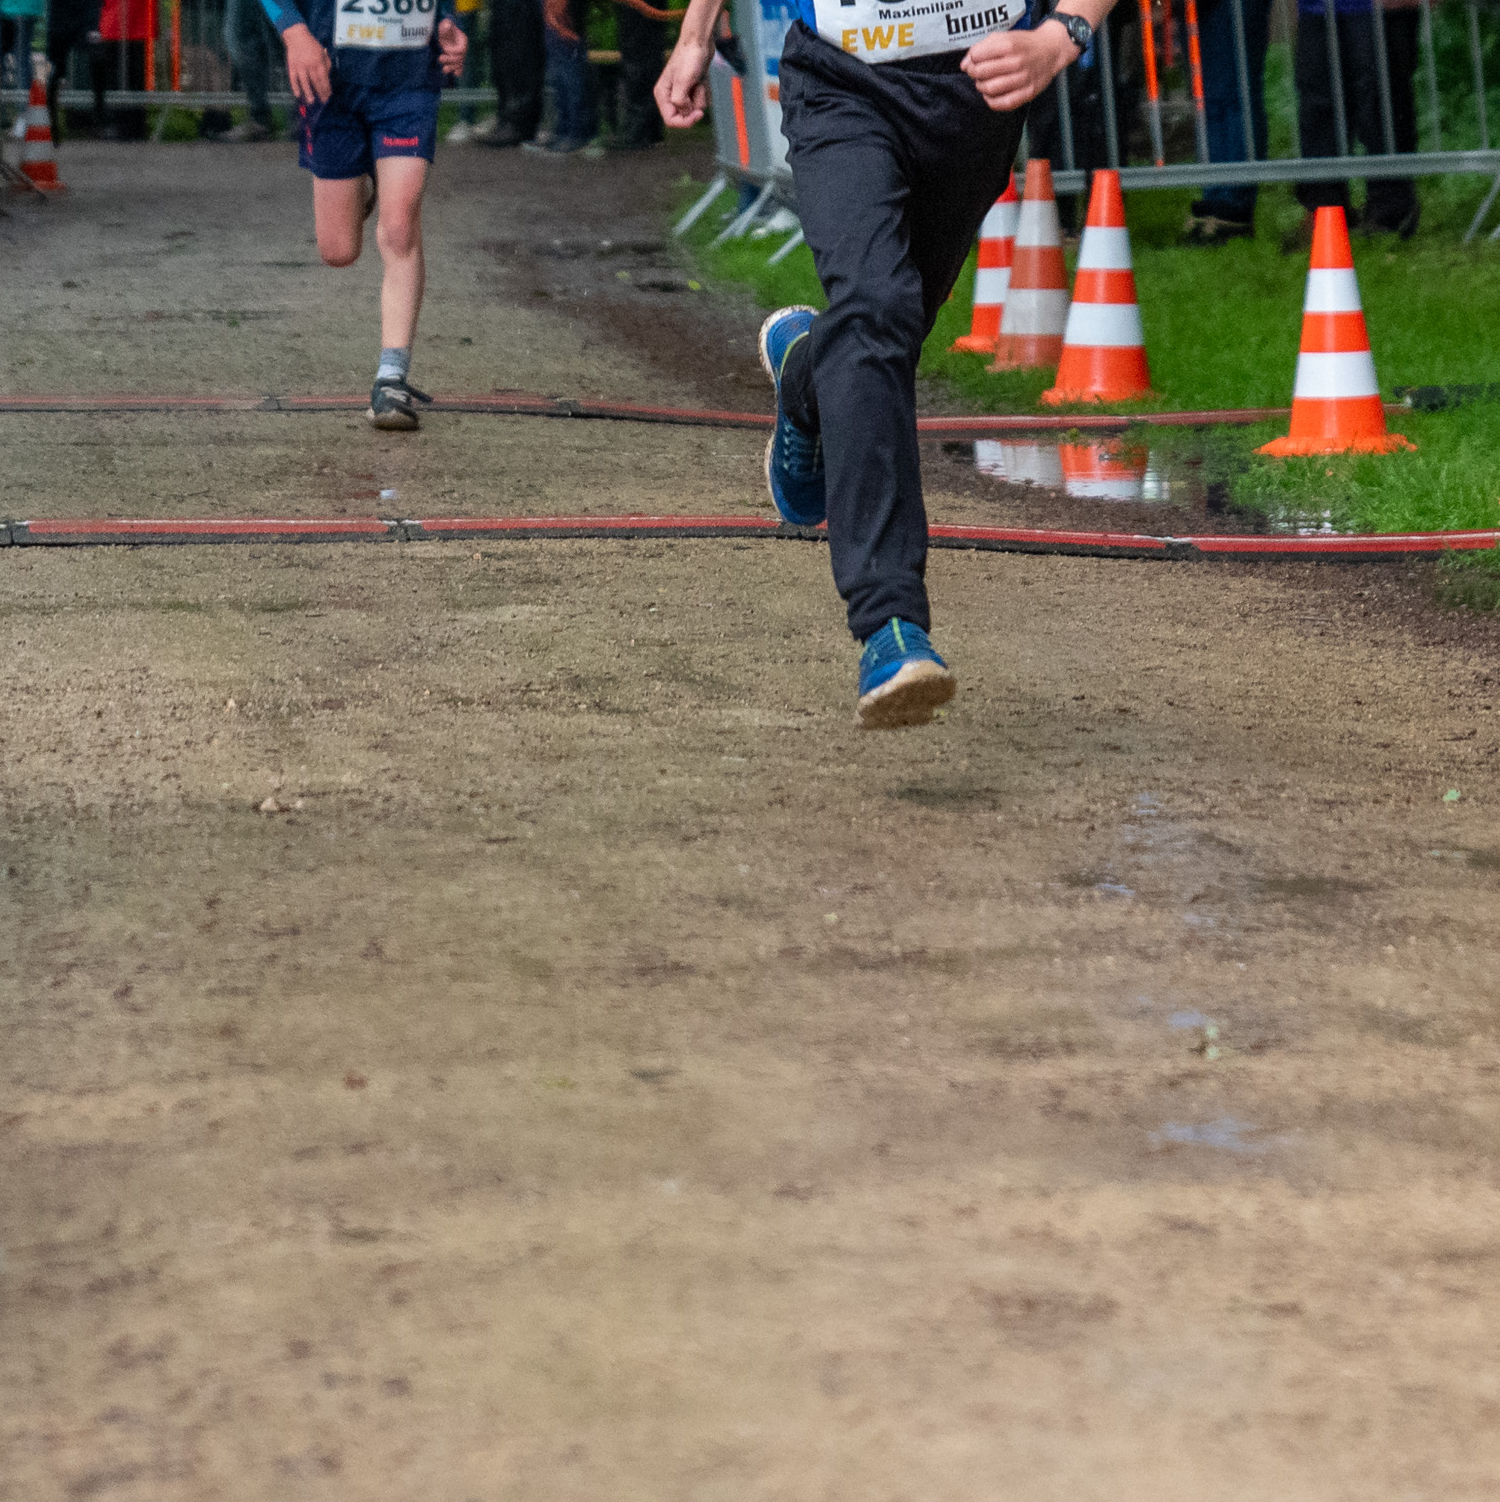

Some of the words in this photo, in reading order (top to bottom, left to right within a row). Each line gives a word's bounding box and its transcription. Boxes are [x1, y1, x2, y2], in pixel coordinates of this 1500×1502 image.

[879, 0, 964, 20] Maximilian
[945, 4, 1009, 36] bruns
[842, 23, 915, 53] EWE
